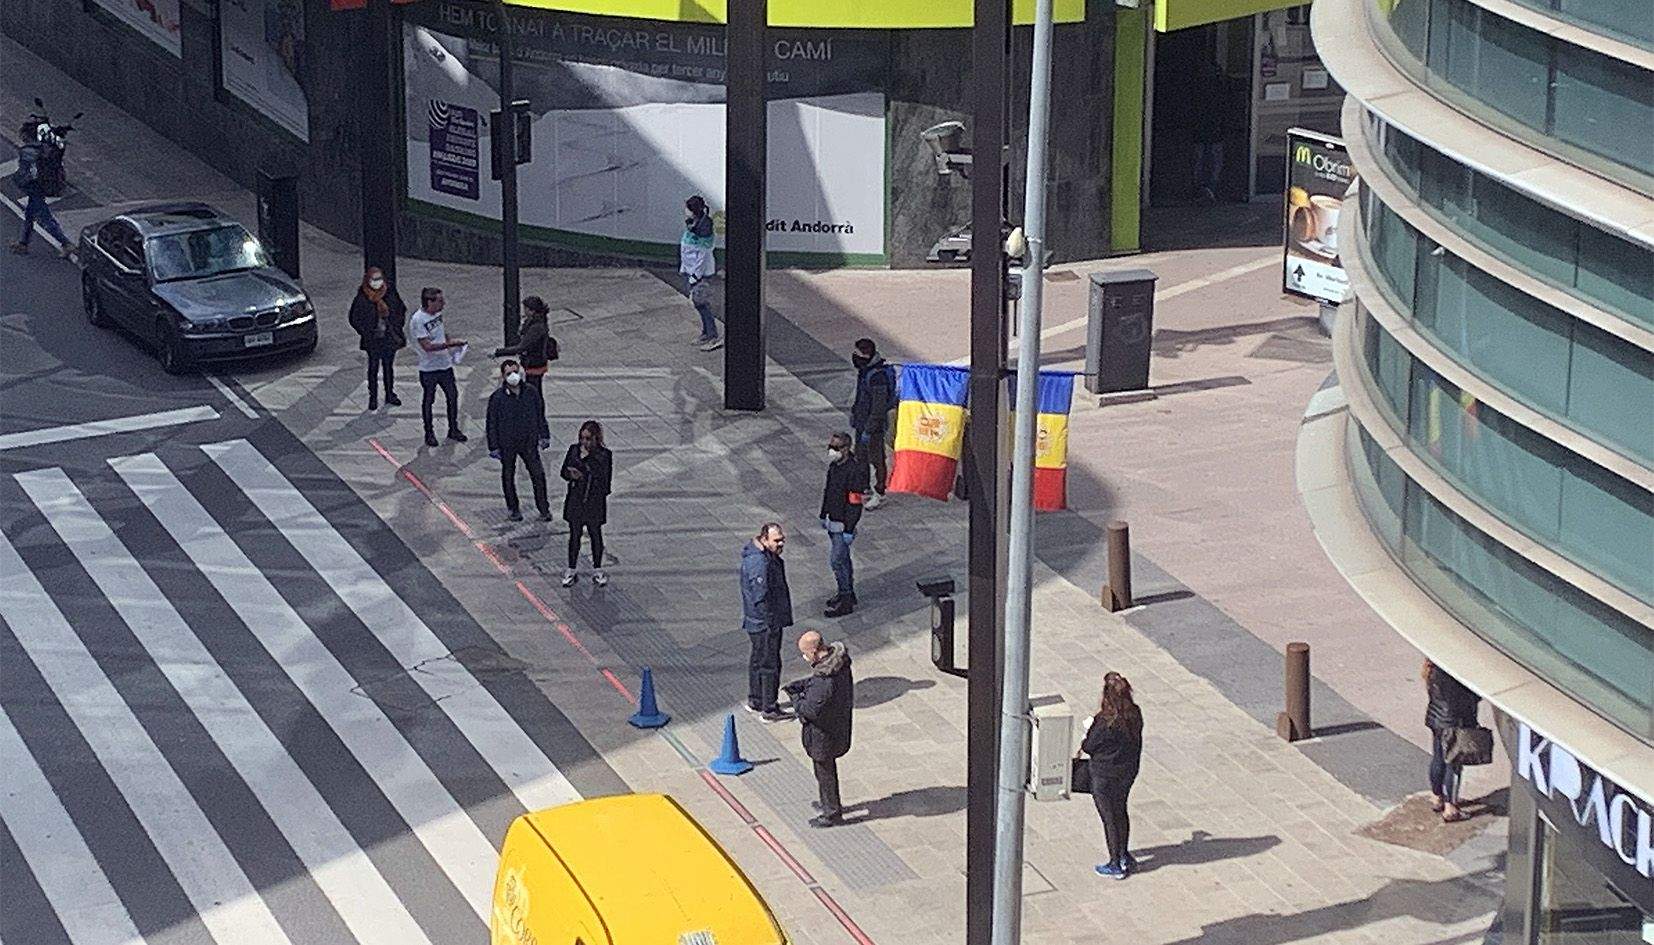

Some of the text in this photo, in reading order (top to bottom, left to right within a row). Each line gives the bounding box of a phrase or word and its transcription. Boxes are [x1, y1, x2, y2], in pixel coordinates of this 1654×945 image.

[476, 9, 545, 37] TONAT
[572, 24, 650, 51] TRAÇAR
[656, 32, 681, 53] EL
[774, 37, 834, 60] CAMÍ
[790, 218, 855, 235] Andorrà
